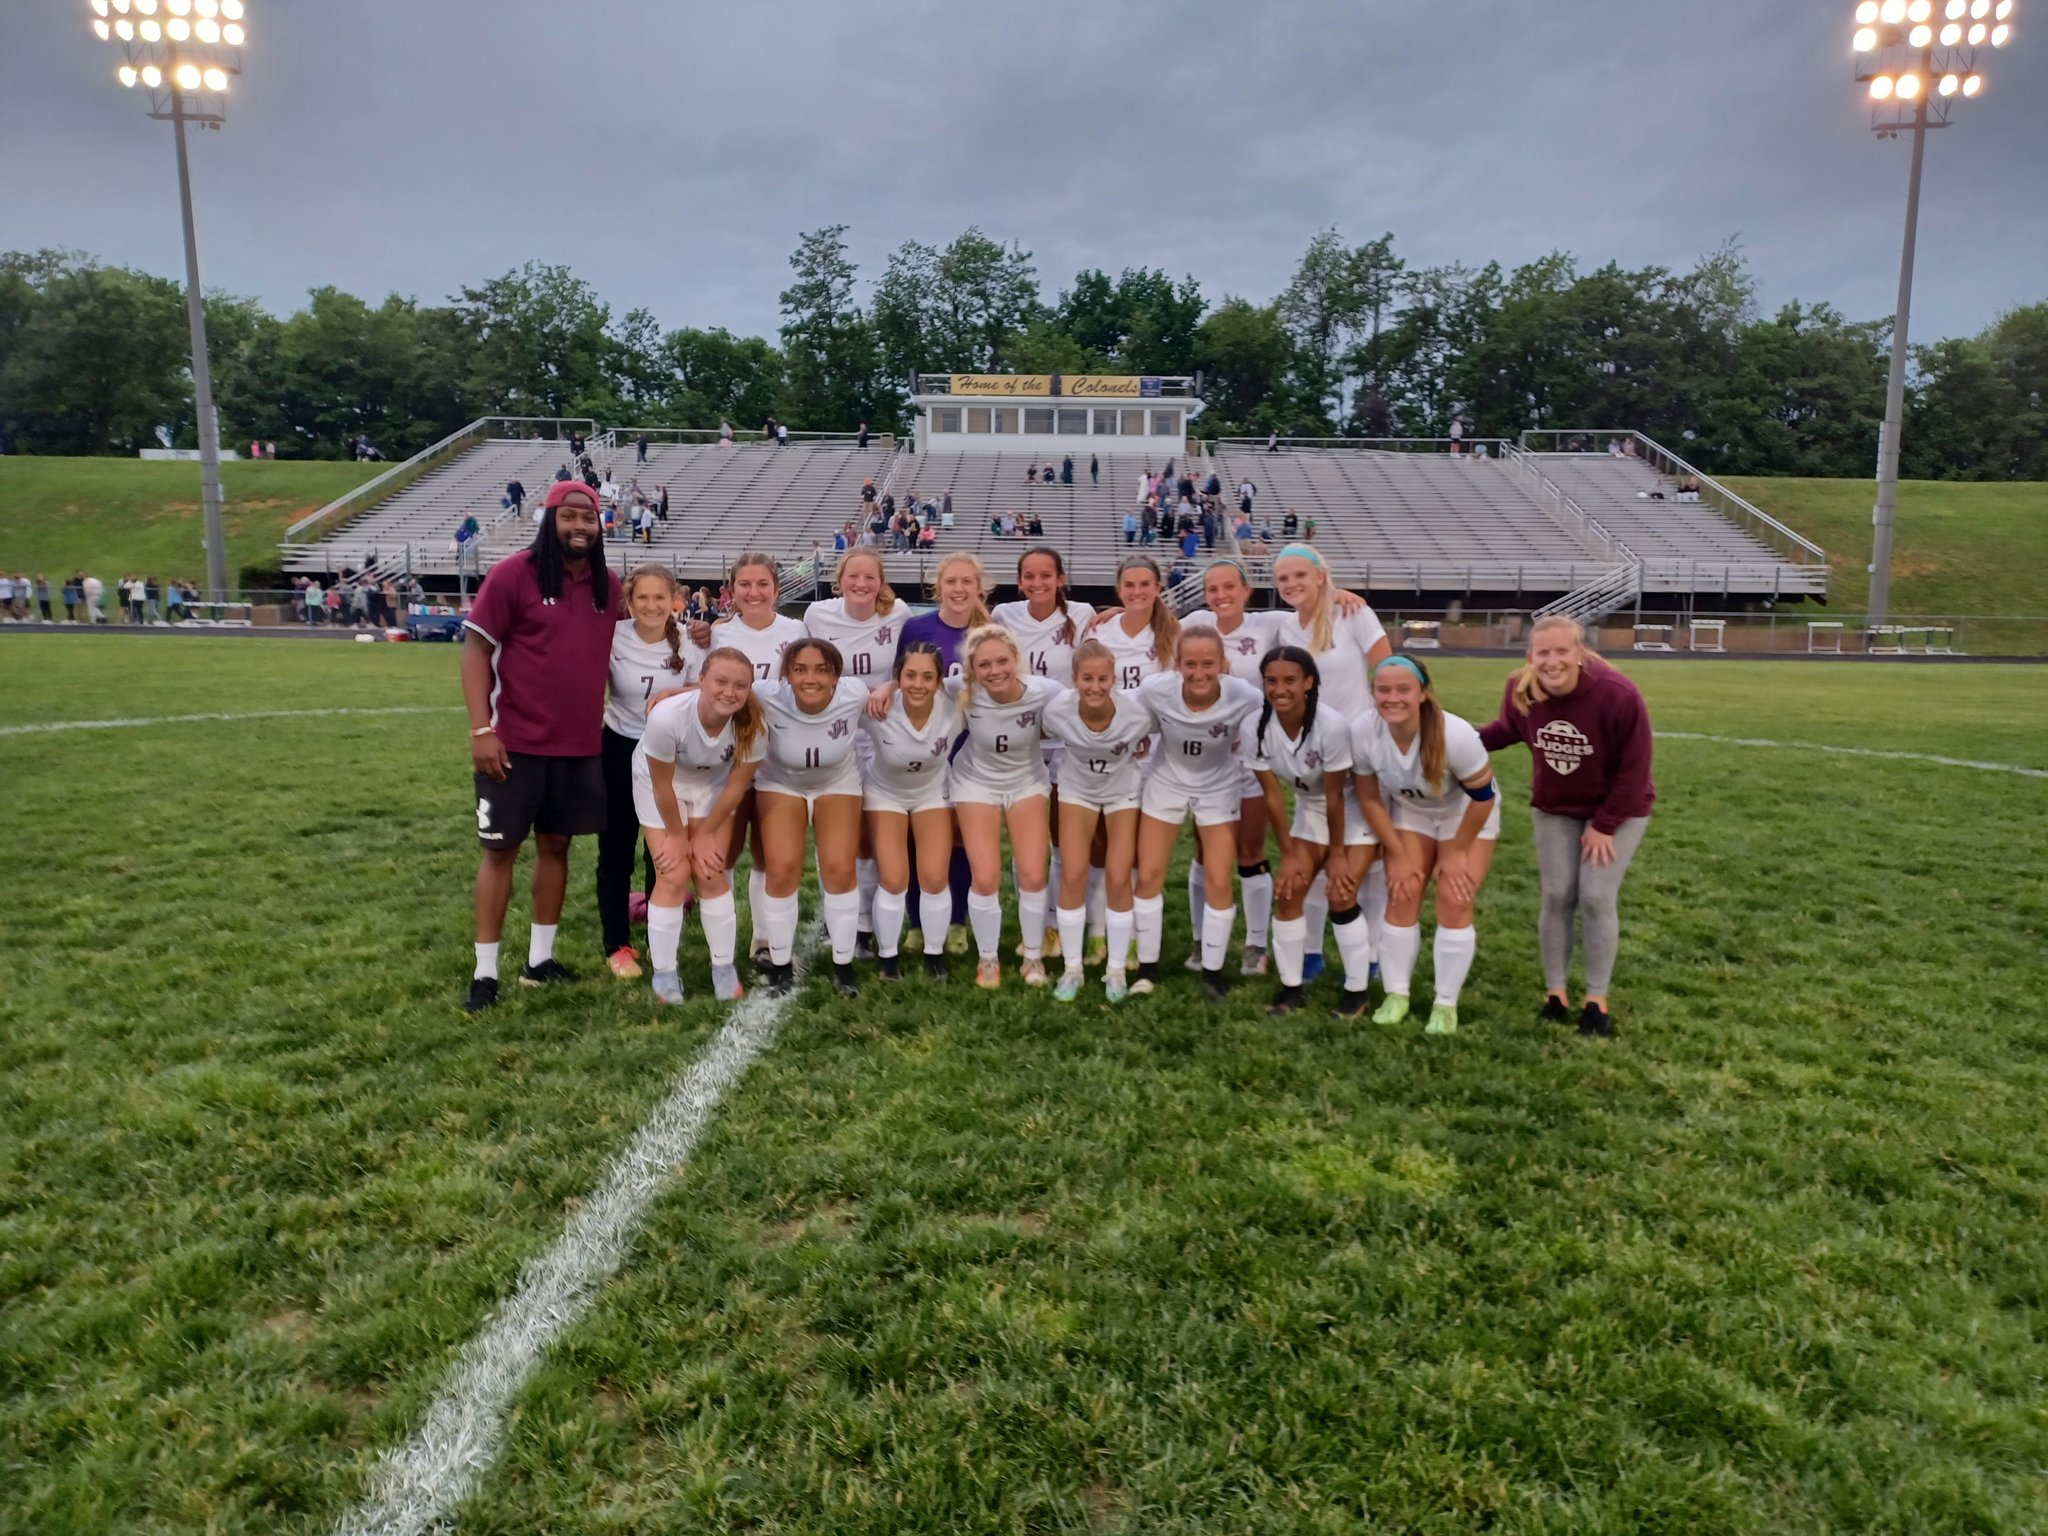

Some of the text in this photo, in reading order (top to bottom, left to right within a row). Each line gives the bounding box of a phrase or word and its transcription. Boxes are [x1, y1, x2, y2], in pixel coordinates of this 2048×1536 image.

[958, 376, 999, 389] Home
[1004, 378, 1019, 393] of
[1022, 377, 1043, 391] the
[1072, 377, 1138, 394] Colonels
[852, 653, 871, 675] 10
[1029, 651, 1048, 676] 14
[641, 676, 654, 700] 7
[1123, 666, 1140, 690] 13
[995, 735, 1008, 753] 6
[1183, 740, 1202, 756] 16
[1533, 736, 1594, 755] JUDGES
[805, 747, 819, 768] 11
[907, 761, 922, 773] 3
